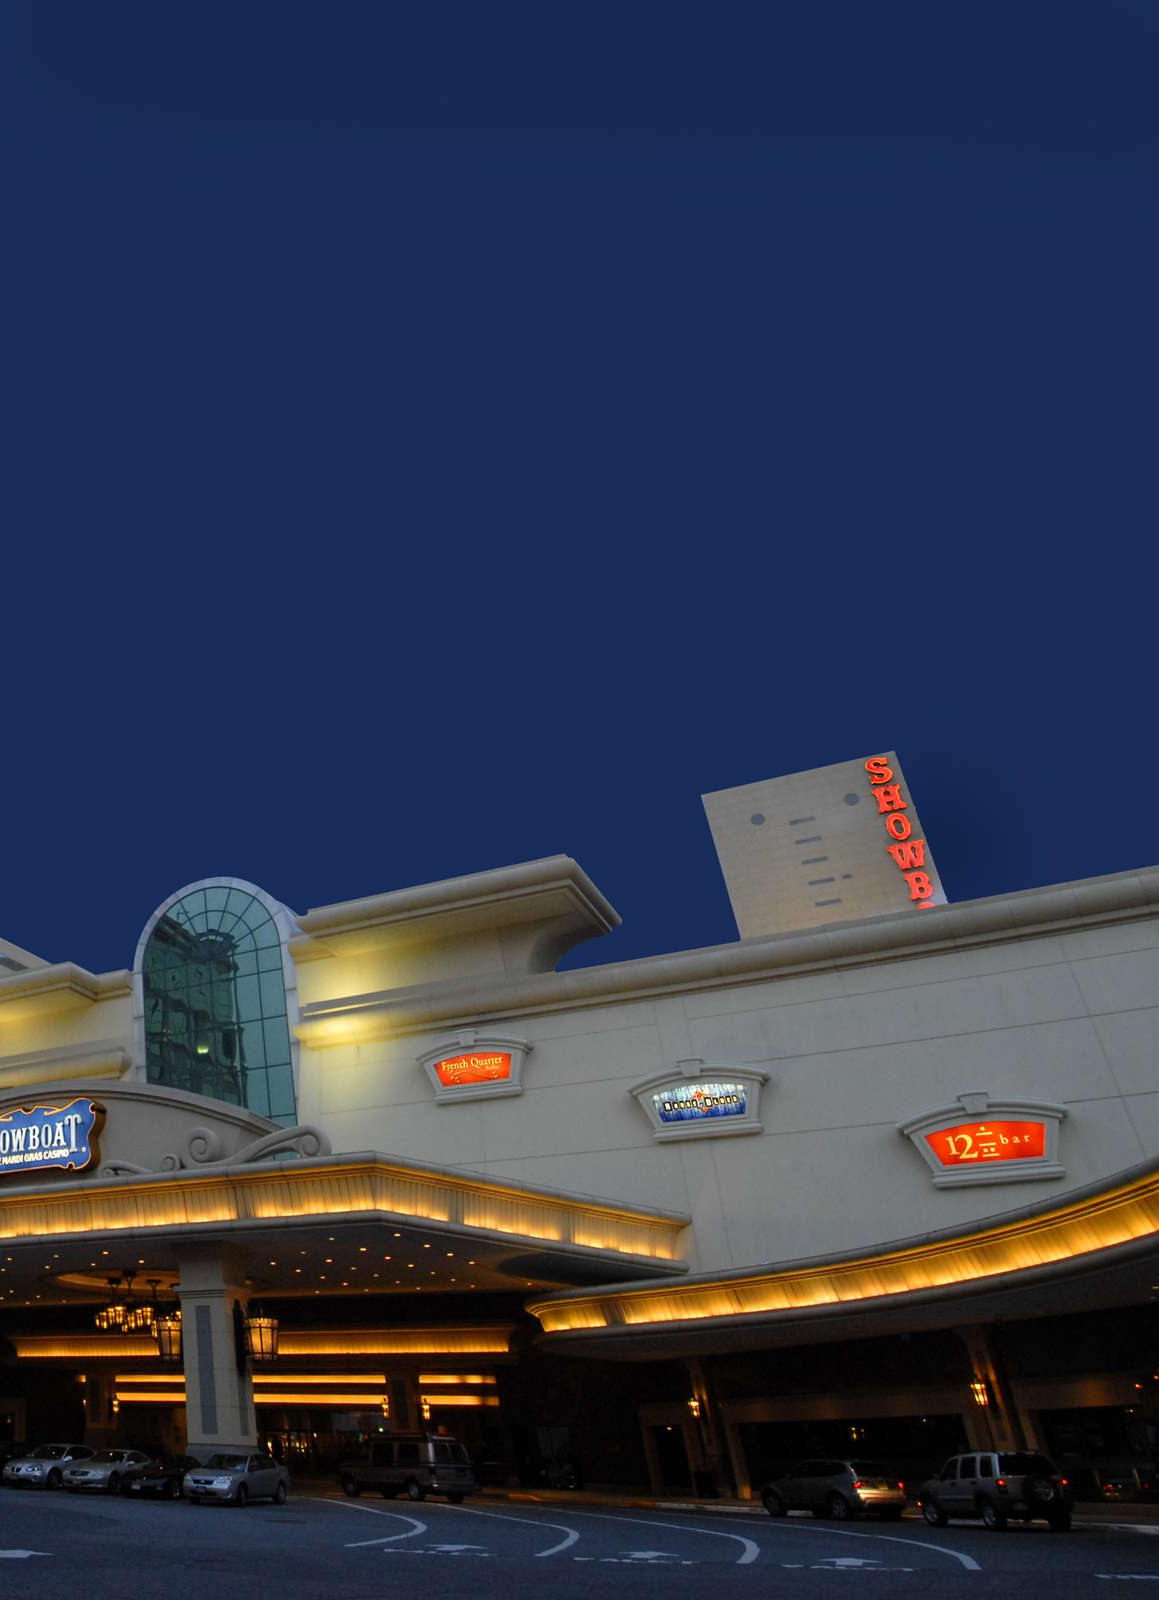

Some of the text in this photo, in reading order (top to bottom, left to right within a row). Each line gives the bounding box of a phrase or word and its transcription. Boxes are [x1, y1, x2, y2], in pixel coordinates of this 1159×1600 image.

[864, 757, 936, 910] SHOWB
[441, 1058, 469, 1071] French
[470, 1056, 503, 1069] Quarter
[945, 1133, 1030, 1160] 12 bar
